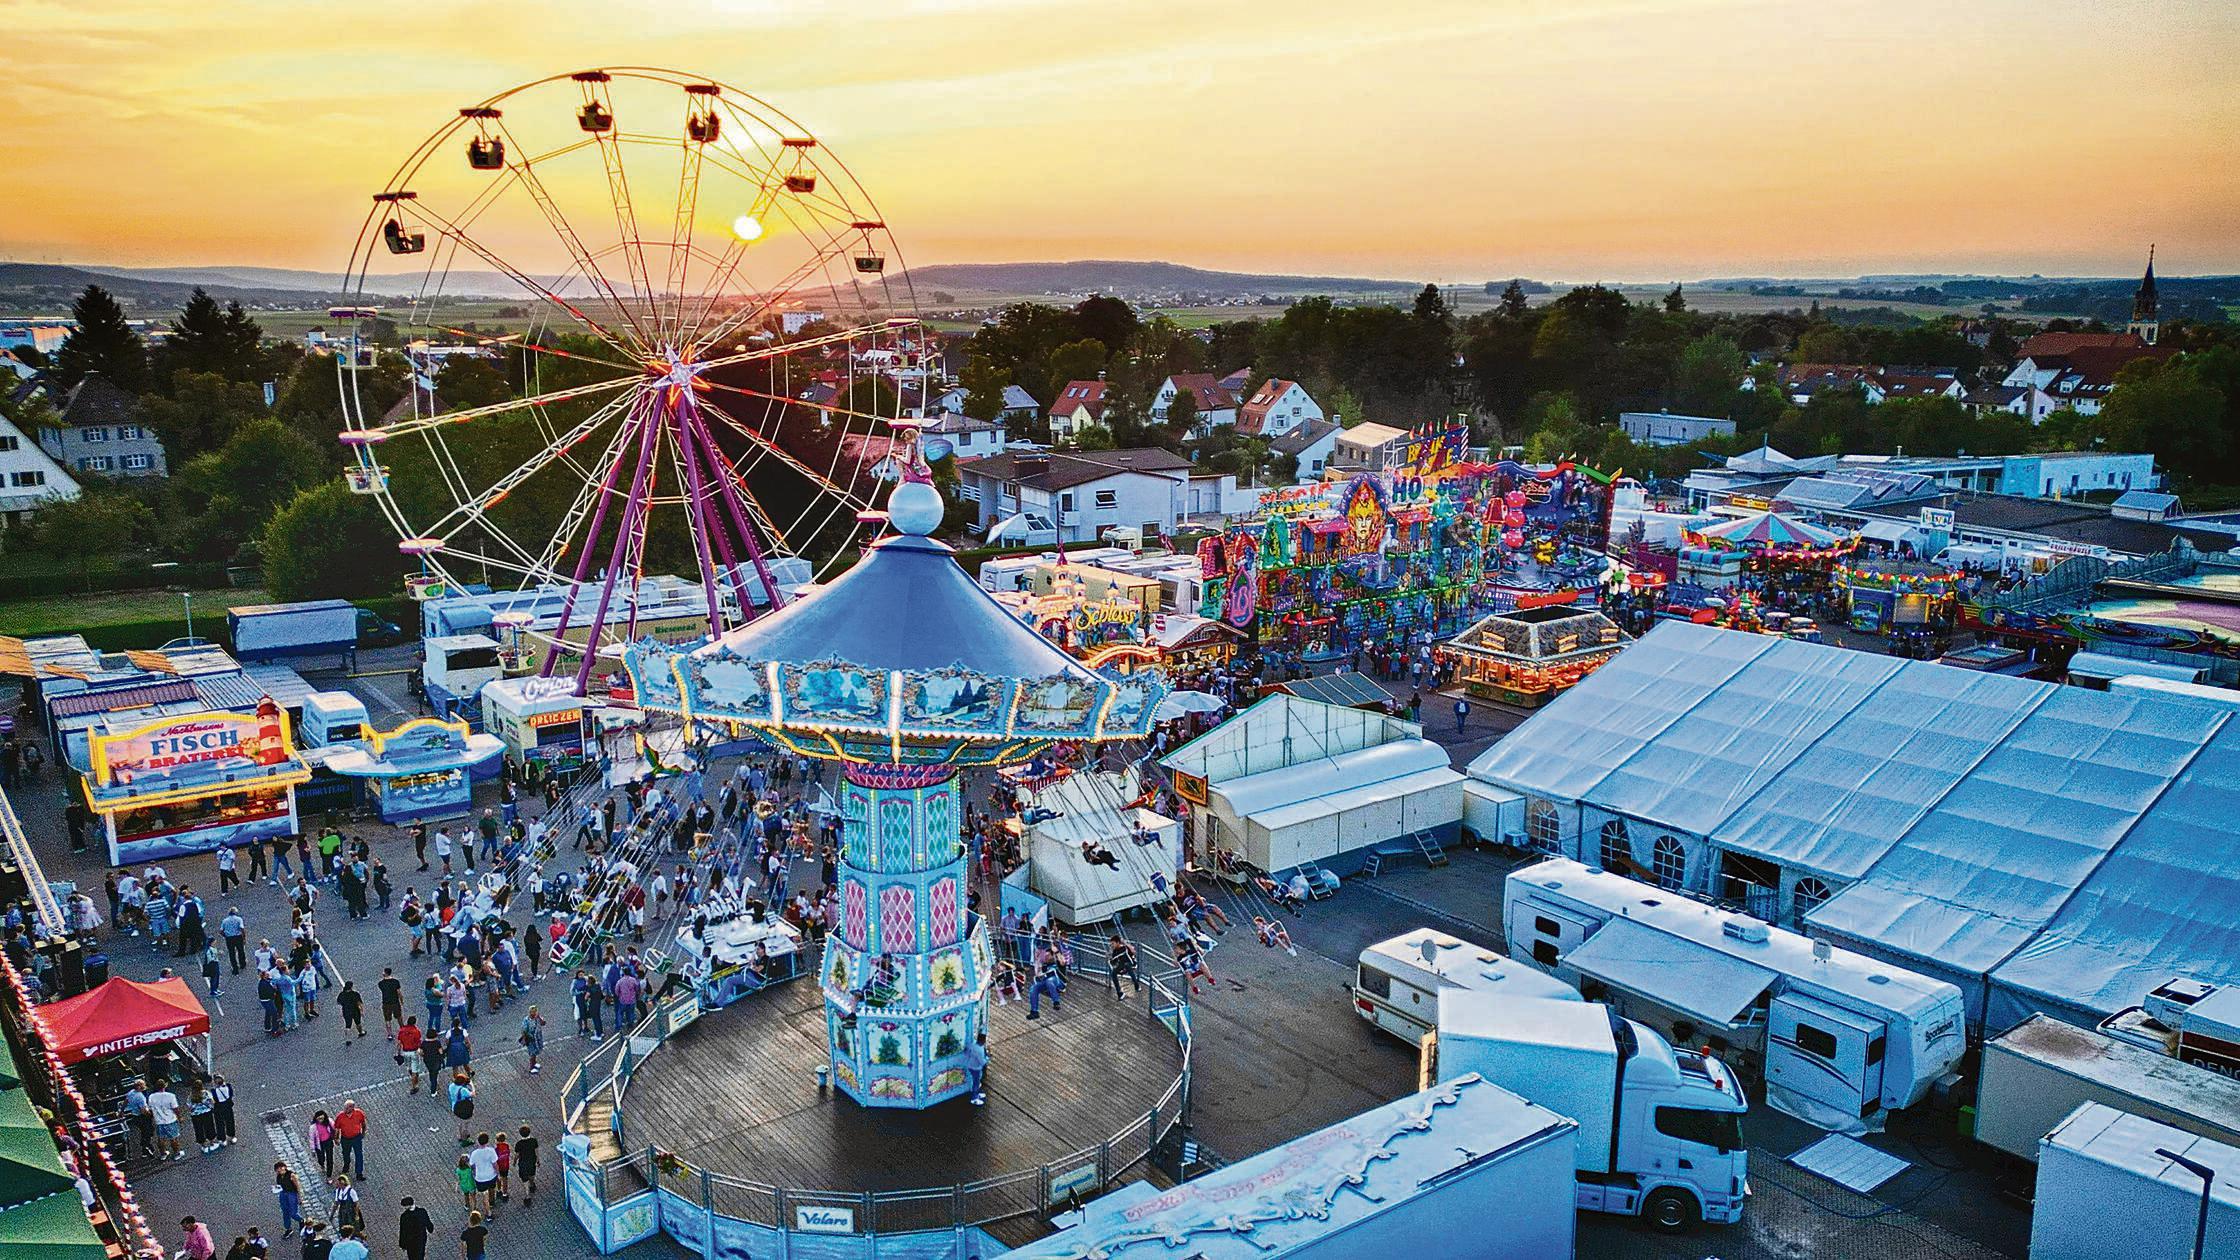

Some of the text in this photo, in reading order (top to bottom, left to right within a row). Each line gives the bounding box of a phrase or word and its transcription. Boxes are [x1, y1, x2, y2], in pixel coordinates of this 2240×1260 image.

[150, 729, 239, 756] FISCH
[149, 745, 244, 769] BRATEREI
[100, 1025, 186, 1054] INTERSPORT
[800, 1212, 848, 1226] Volare
